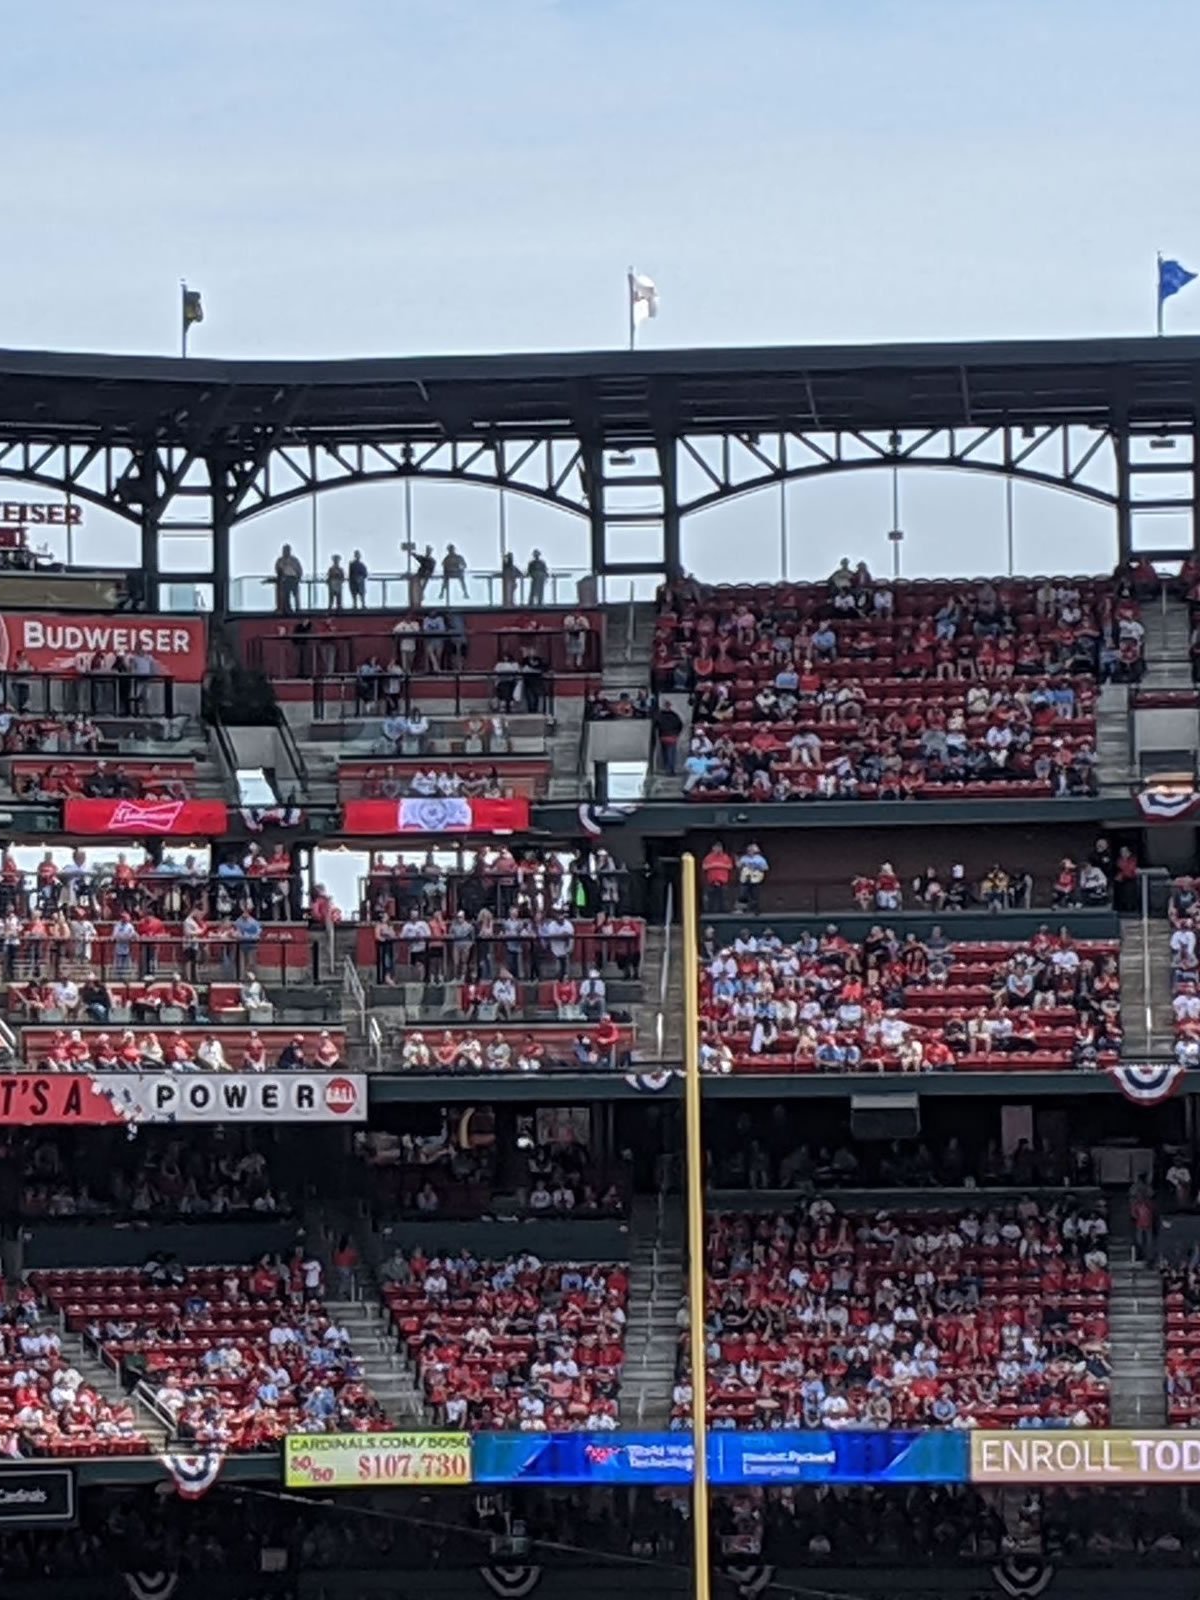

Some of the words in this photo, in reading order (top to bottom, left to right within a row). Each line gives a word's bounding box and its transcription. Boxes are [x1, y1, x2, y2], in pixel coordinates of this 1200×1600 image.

[23, 620, 191, 653] BUDWEISER
[63, 1080, 84, 1116] A
[155, 1083, 315, 1109] POWER
[358, 1454, 467, 1480] $107,730
[980, 1439, 1122, 1472] ENROLL
